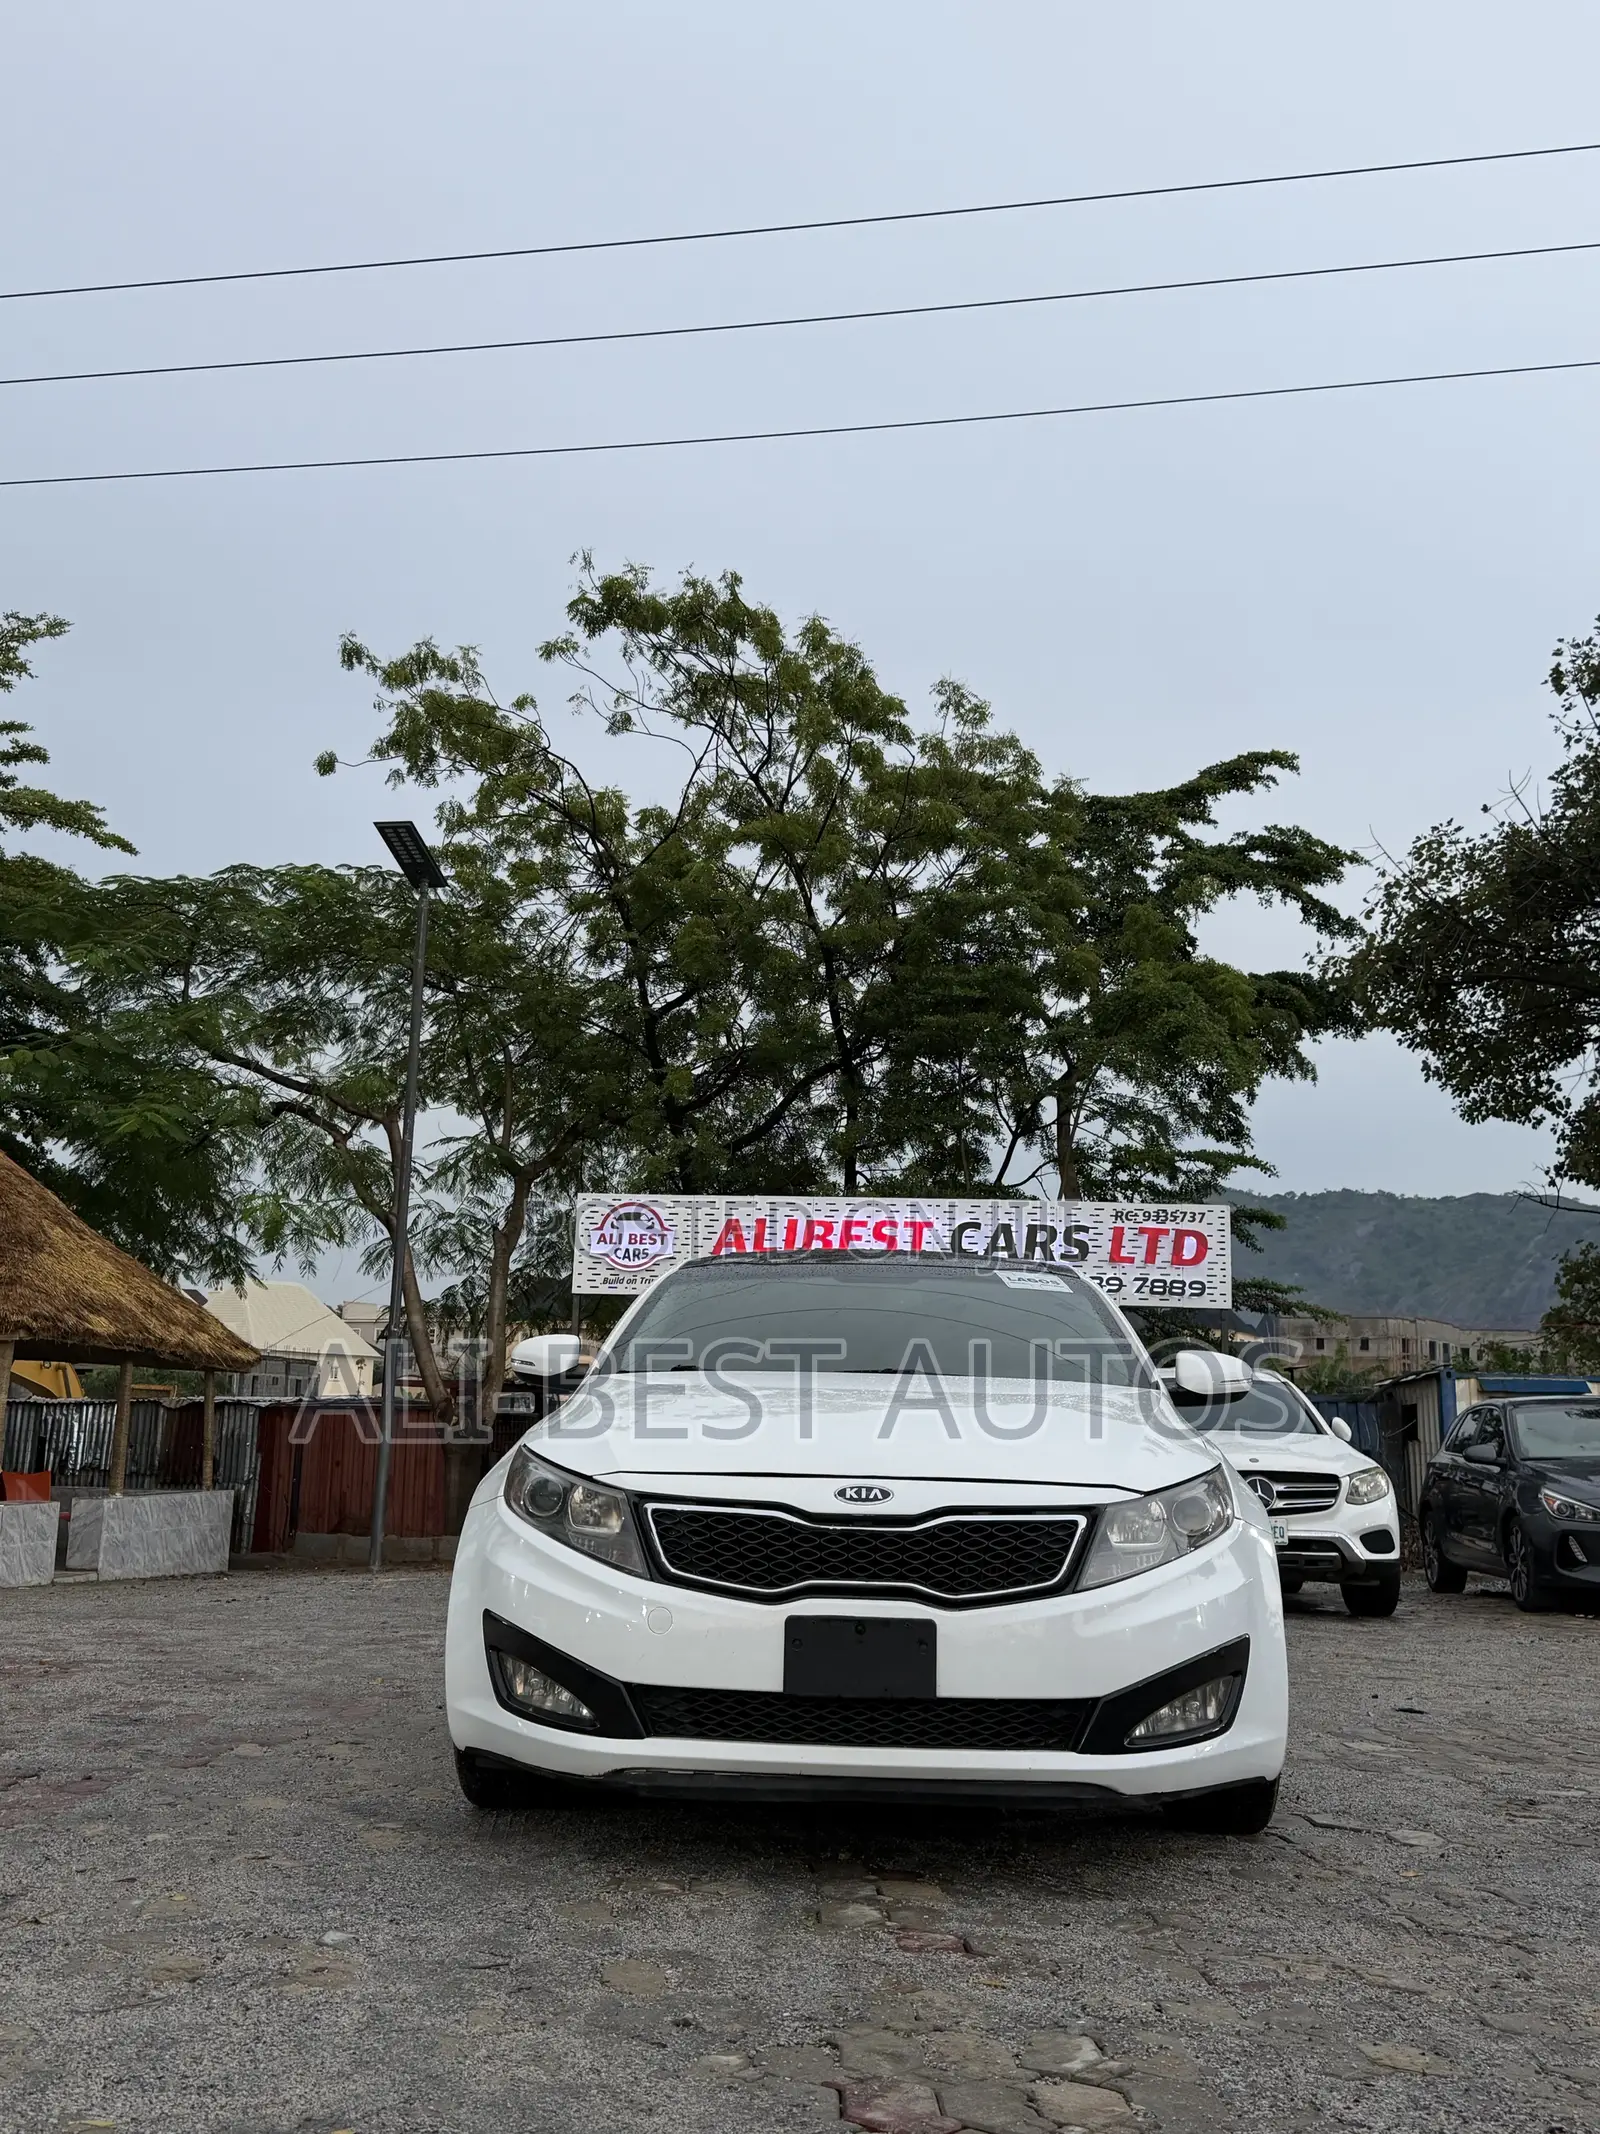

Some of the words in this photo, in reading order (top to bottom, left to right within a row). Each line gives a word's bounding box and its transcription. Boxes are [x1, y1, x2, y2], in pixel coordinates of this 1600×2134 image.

[596, 1232, 624, 1246] ALI
[628, 1233, 667, 1246] BEST
[711, 1218, 934, 1255] ALIBEST
[950, 1221, 1091, 1262] CARS
[1108, 1226, 1209, 1267] LTD
[613, 1247, 650, 1262] CARS
[1132, 1276, 1207, 1298] 7889
[845, 1487, 883, 1500] KIA
